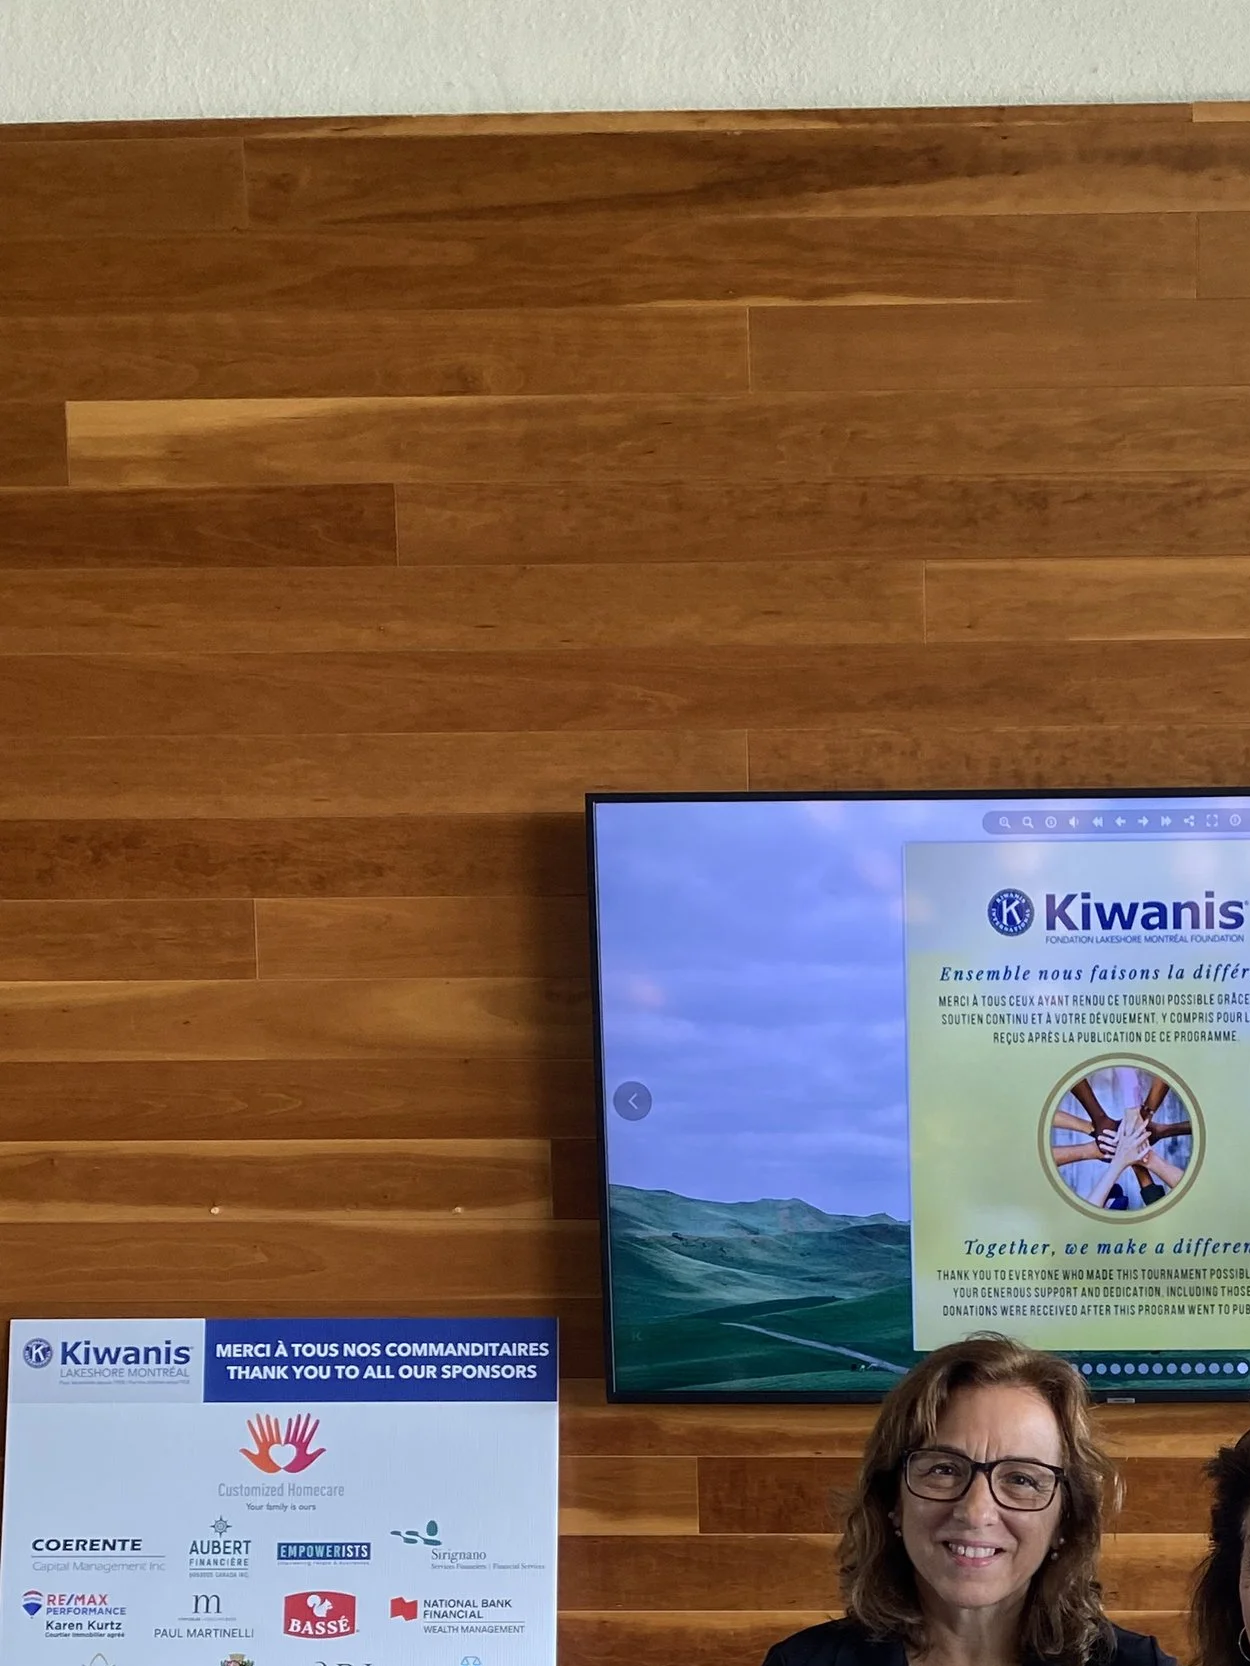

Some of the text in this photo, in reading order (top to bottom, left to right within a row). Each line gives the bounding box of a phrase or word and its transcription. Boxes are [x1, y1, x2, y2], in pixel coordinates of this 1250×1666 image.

[1046, 890, 1244, 931] Kiwanis
[1046, 934, 1244, 944] FONDATION LAKESHORE MONTRÉAL FOUNDATION
[940, 965, 1030, 981] Ensemble
[1039, 969, 1082, 980] nous
[1090, 965, 1160, 983] faisons
[1168, 964, 1184, 980] la
[939, 996, 969, 1007] MERCI
[972, 994, 978, 1006] À
[981, 995, 1006, 1006] TOUS
[1009, 995, 1034, 1006] CEUX
[1038, 995, 1069, 1006] AYANT
[1072, 994, 1105, 1006] RENDU
[1108, 994, 1119, 1006] CE
[1122, 994, 1164, 1006] TOURNOI
[1168, 994, 1214, 1005] POSSIBLE
[1218, 992, 1250, 1005] GRÂCE
[942, 1014, 983, 1025] SOUTIEN
[986, 1013, 1028, 1024] CONTINU
[1031, 1013, 1043, 1024] ET
[1046, 1012, 1052, 1024] À
[1055, 1013, 1086, 1024] VOTRE
[1090, 1012, 1158, 1024] DÉVOUEMENT,
[1162, 1012, 1167, 1023] Y
[1170, 1012, 1214, 1023] COMPRIS
[1217, 1012, 1242, 1023] POUR
[994, 1030, 1239, 1045] REÇUS APRÈS LA PUBLICATION DE CE PROGRAMME.
[964, 1239, 1055, 1258] Together,
[1065, 1244, 1088, 1255] we
[1097, 1238, 1147, 1254] make
[1155, 1243, 1164, 1254] a
[937, 1270, 970, 1280] THANK
[972, 1270, 991, 1280] YOU
[994, 1270, 1006, 1280] TO
[1008, 1269, 1059, 1280] EVERYONE
[1062, 1269, 1084, 1280] WHO
[1086, 1269, 1114, 1280] MADE
[1116, 1269, 1138, 1280] THIS
[1141, 1268, 1207, 1280] TOURNAMENT
[953, 1287, 978, 1298] YOUR
[981, 1287, 1032, 1298] GENEROUS
[1034, 1286, 1078, 1298] SUPPORT
[1081, 1286, 1100, 1298] AND
[1103, 1286, 1164, 1297] DEDICATION,
[1166, 1286, 1218, 1297] INCLUDING
[943, 1305, 997, 1316] DONATIONS
[1000, 1305, 1027, 1316] WERE
[1030, 1305, 1077, 1316] RECEIVED
[1080, 1304, 1111, 1316] AFTER
[1114, 1305, 1135, 1315] THIS
[1138, 1304, 1185, 1315] PROGRAM
[1188, 1304, 1215, 1315] WENT
[1218, 1304, 1230, 1314] TO
[61, 1340, 190, 1365] Kiwanis
[216, 1340, 549, 1357] MERCI À TOUS NOS COMMANDITAIRES
[60, 1366, 190, 1378] LAKESHORE MONTRÉAL
[227, 1365, 537, 1379] THANK YOU TO ALL OUR SPONSORS
[218, 1483, 344, 1496] Customized Homecare
[266, 1502, 288, 1512] family
[32, 1539, 142, 1551] COERENTE
[189, 1540, 252, 1554] AUBERT
[280, 1545, 368, 1558] EMPOWERISTS
[432, 1548, 486, 1563] Sirignano
[32, 1562, 166, 1573] Capital Management Inc
[189, 1557, 248, 1566] FINANCIÈRE
[47, 1594, 108, 1606] RE/MAX
[424, 1599, 512, 1608] NATIONAL BANK
[46, 1607, 126, 1615] PERFORMANCE
[423, 1610, 483, 1619] FINANCIAL
[46, 1620, 122, 1630] Karen Kurtz
[288, 1616, 350, 1634] BASSÉ
[154, 1628, 254, 1638] PAUL MARTINELLI
